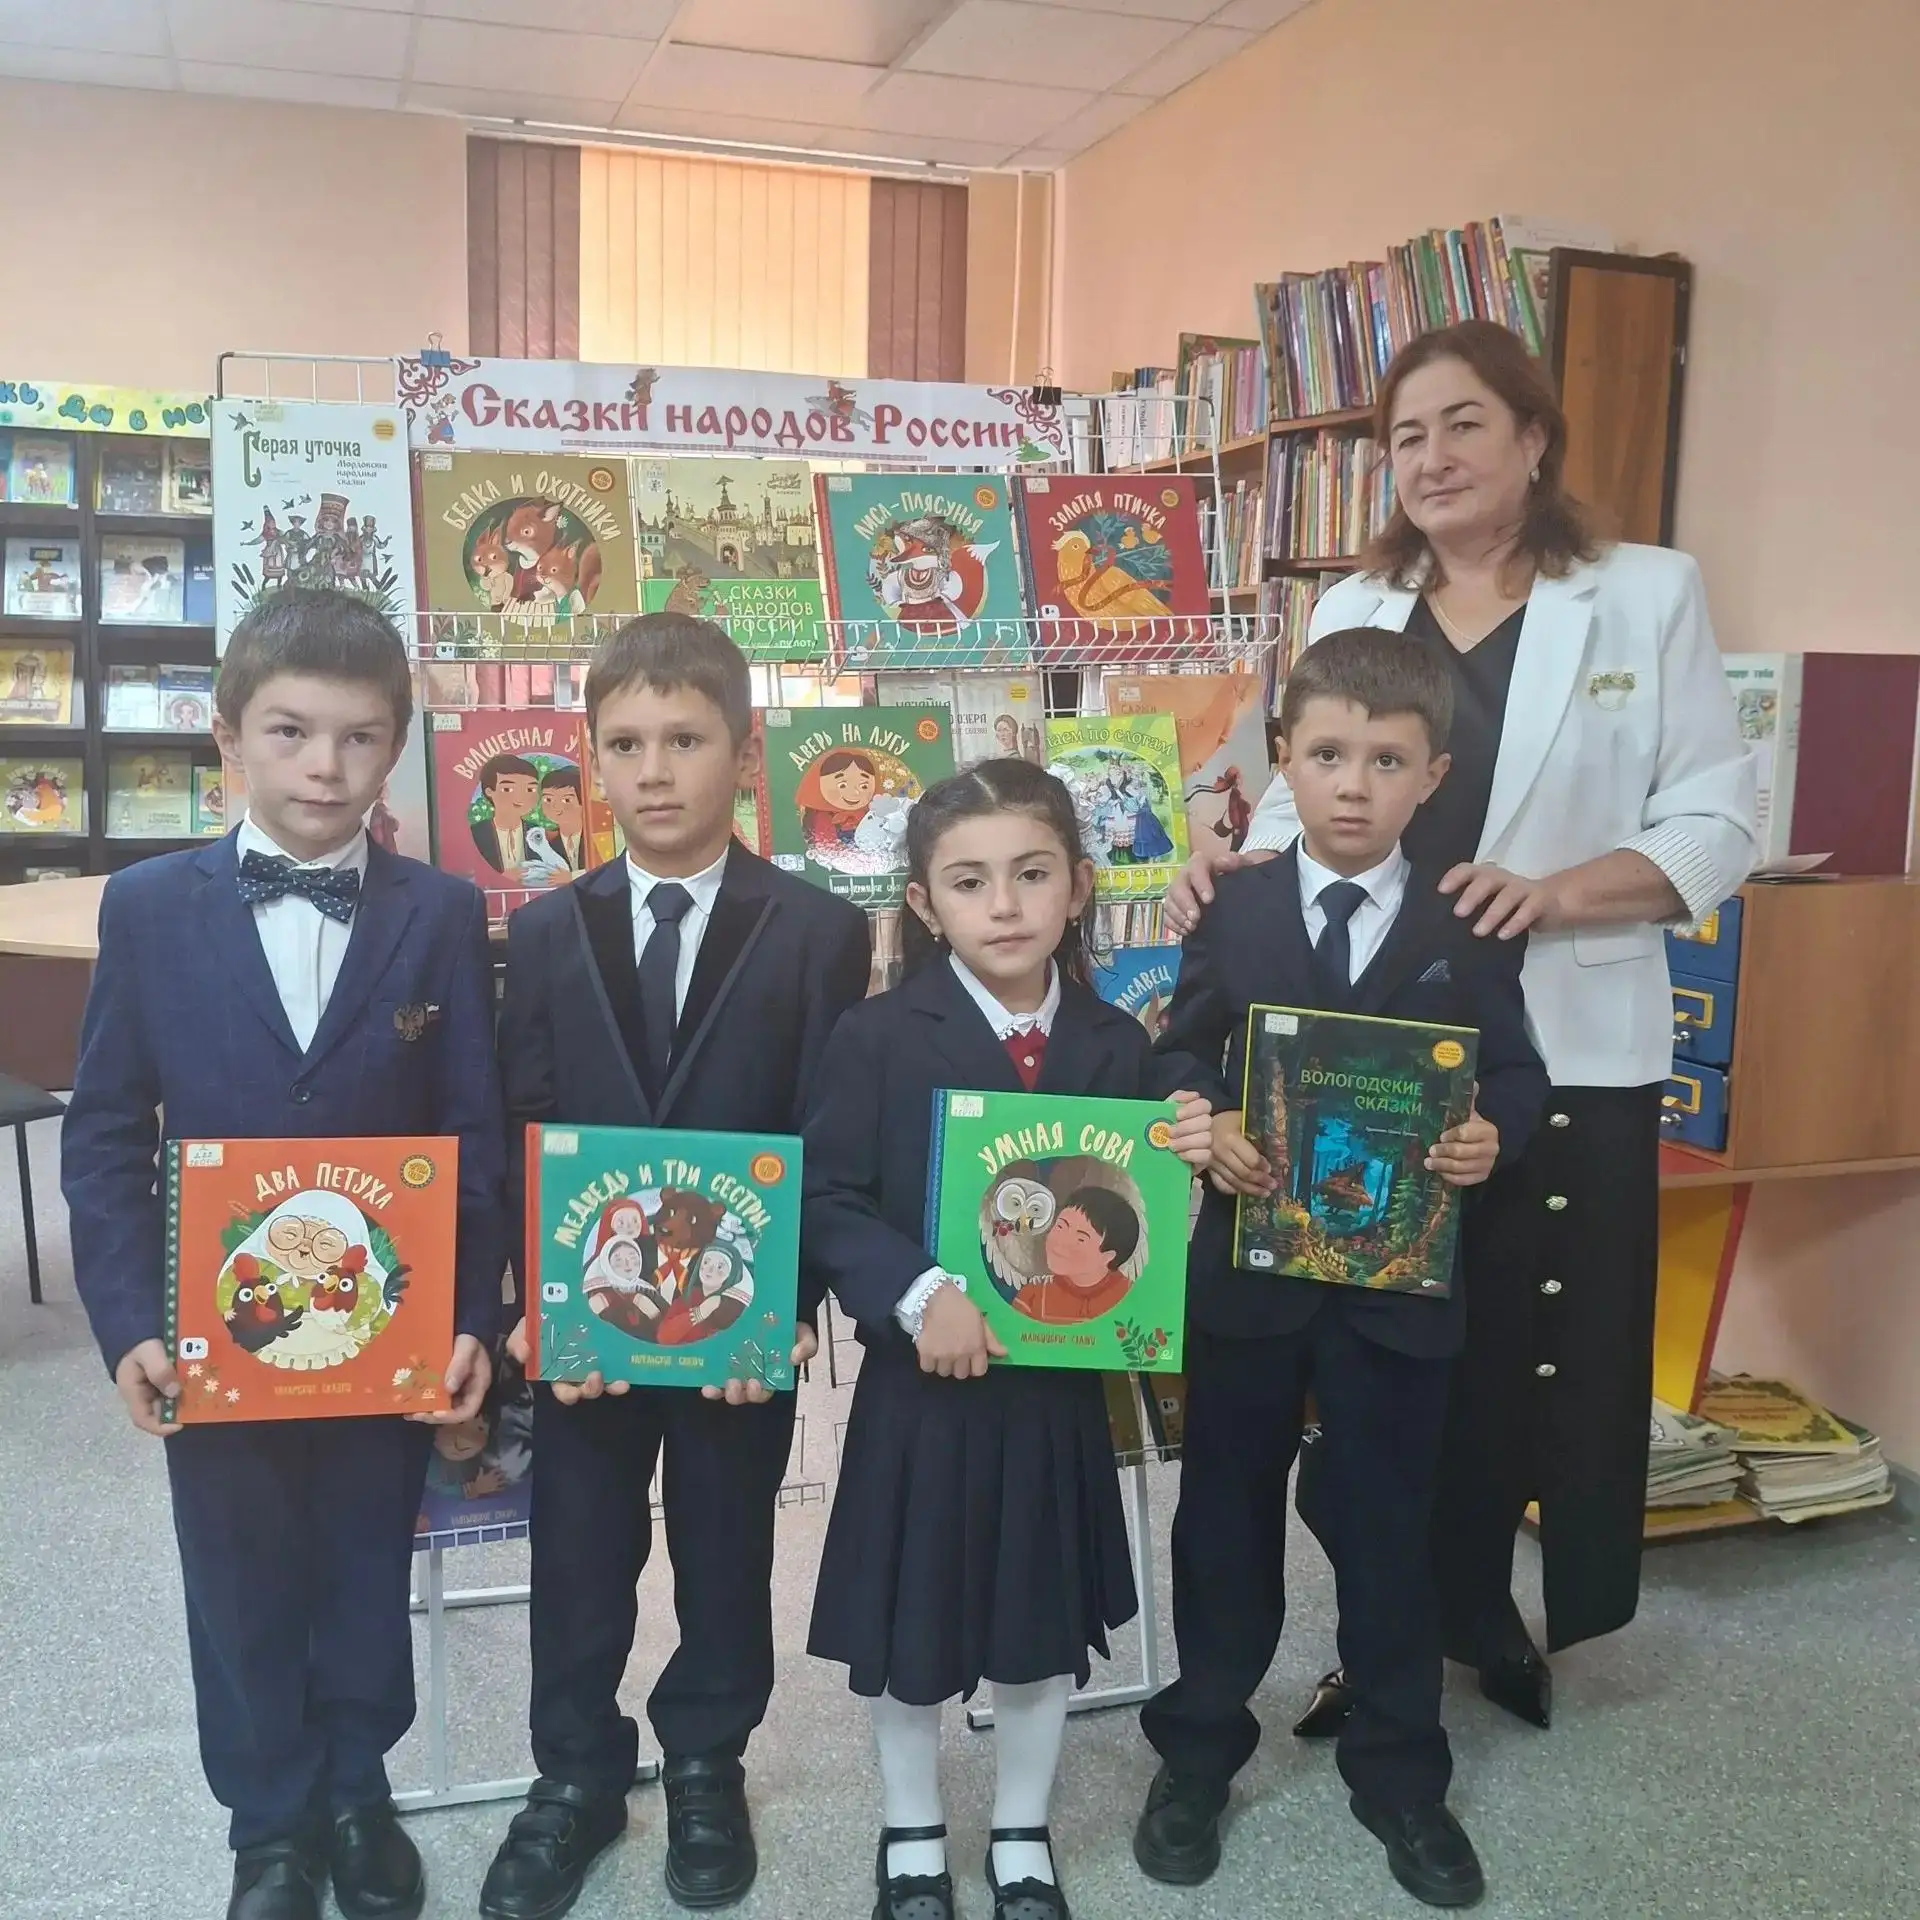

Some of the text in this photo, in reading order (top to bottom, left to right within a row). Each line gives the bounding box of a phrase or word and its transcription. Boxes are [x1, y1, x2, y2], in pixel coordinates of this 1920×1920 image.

[461, 384, 1026, 449] Сказки народов России
[243, 430, 361, 488] Серая уточка
[442, 470, 622, 542] БЕЛКА И ОХОТНИКИ
[1048, 490, 1168, 532] ЗОЛОТАЯ ПТИЧКА
[730, 585, 797, 600] СКАЗКИ
[731, 601, 814, 617] НАРОДОВ
[733, 618, 804, 633] РОССИИ
[453, 726, 554, 780] ВОЛШЕБНАЯ
[788, 722, 911, 772] ДВЕРЬ НА ЛУГУ
[1113, 964, 1173, 1014] РАСАВЕЦ
[1300, 1068, 1425, 1097] ВОЛОГОДСКИЕ
[1354, 1094, 1423, 1117] СКАЗКИ
[977, 1121, 1063, 1175] УМНАЯ
[1079, 1123, 1136, 1168] СОВА
[254, 1164, 301, 1202] ДВА
[316, 1162, 394, 1210] ПЕТУХА
[554, 1159, 772, 1249] МЕДВЕДЬ И ТРИ СЕСТРЫ
